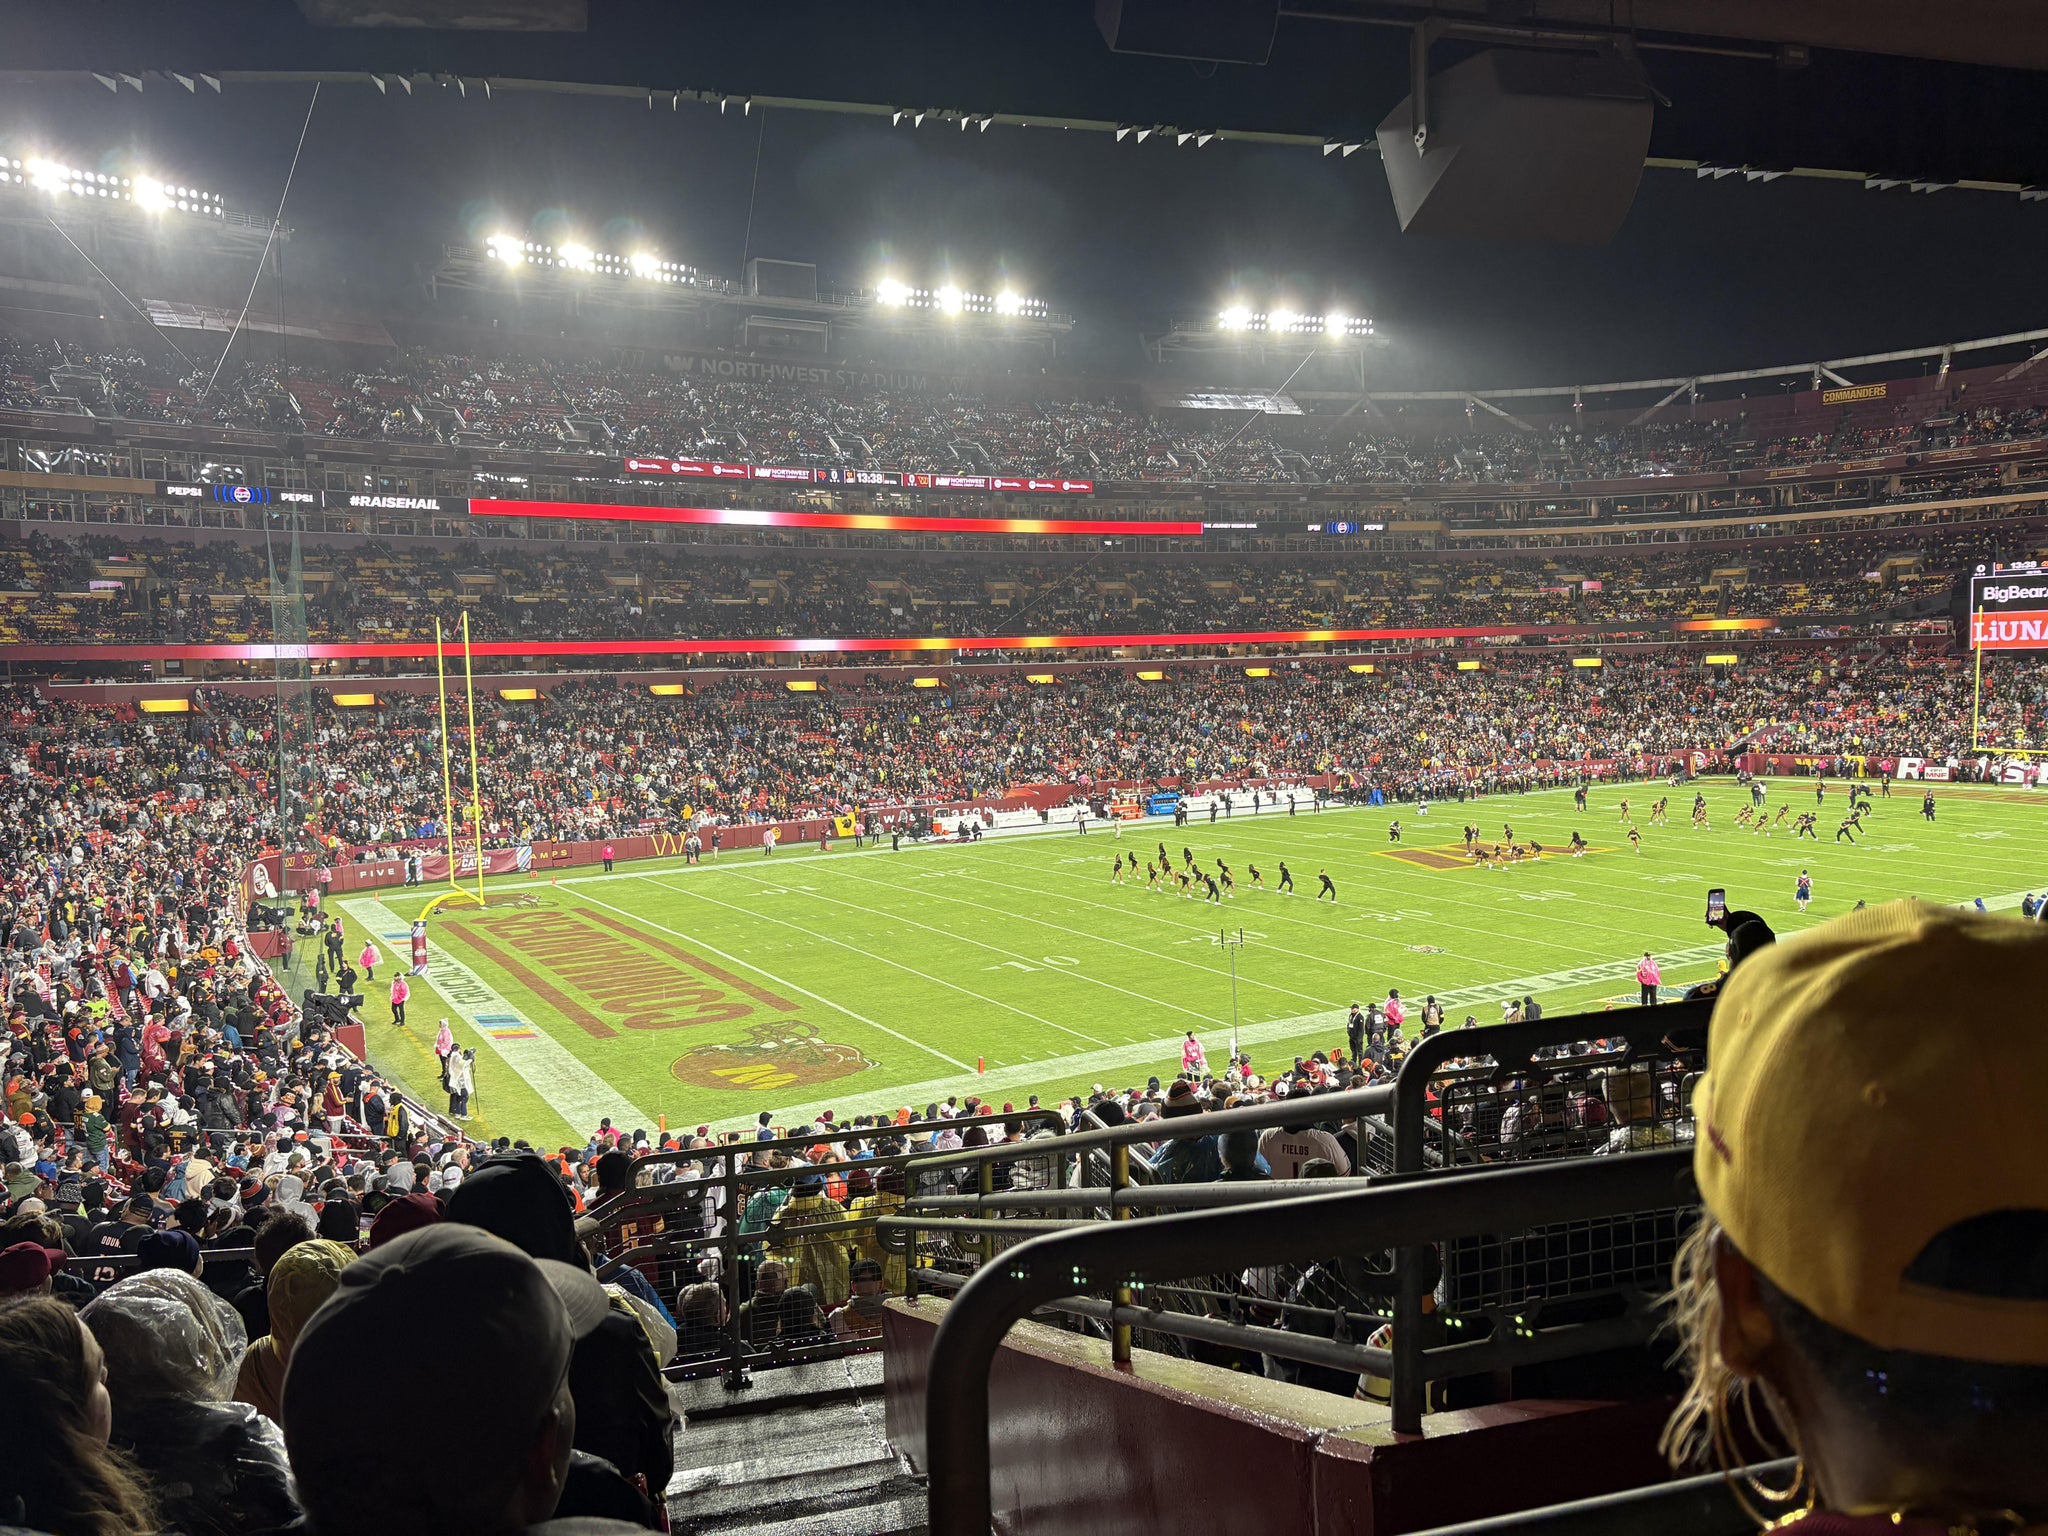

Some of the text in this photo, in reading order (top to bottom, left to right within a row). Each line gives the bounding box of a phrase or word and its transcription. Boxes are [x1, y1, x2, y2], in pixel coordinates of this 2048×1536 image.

[701, 358, 831, 384] NORTHWEST
[836, 369, 927, 391] STADIUM
[1823, 386, 1887, 402] COMMANDERS
[857, 472, 883, 484] 13:38
[951, 477, 985, 485] NORTHWEST
[167, 486, 202, 497] PEPSI
[281, 492, 313, 503] PEPSI
[350, 496, 440, 510] #RAISEHAIL
[2010, 561, 2037, 569] 13:38
[1983, 585, 2048, 603] BigBear.
[461, 856, 491, 868] CATCH
[359, 868, 396, 879] FIVE
[470, 910, 754, 1030] COMMANDERS
[1001, 955, 1080, 974] 10
[1541, 947, 1728, 987] INTECEPT
[1282, 1143, 1309, 1156] FIELDS
[101, 1235, 121, 1249] ODUN
